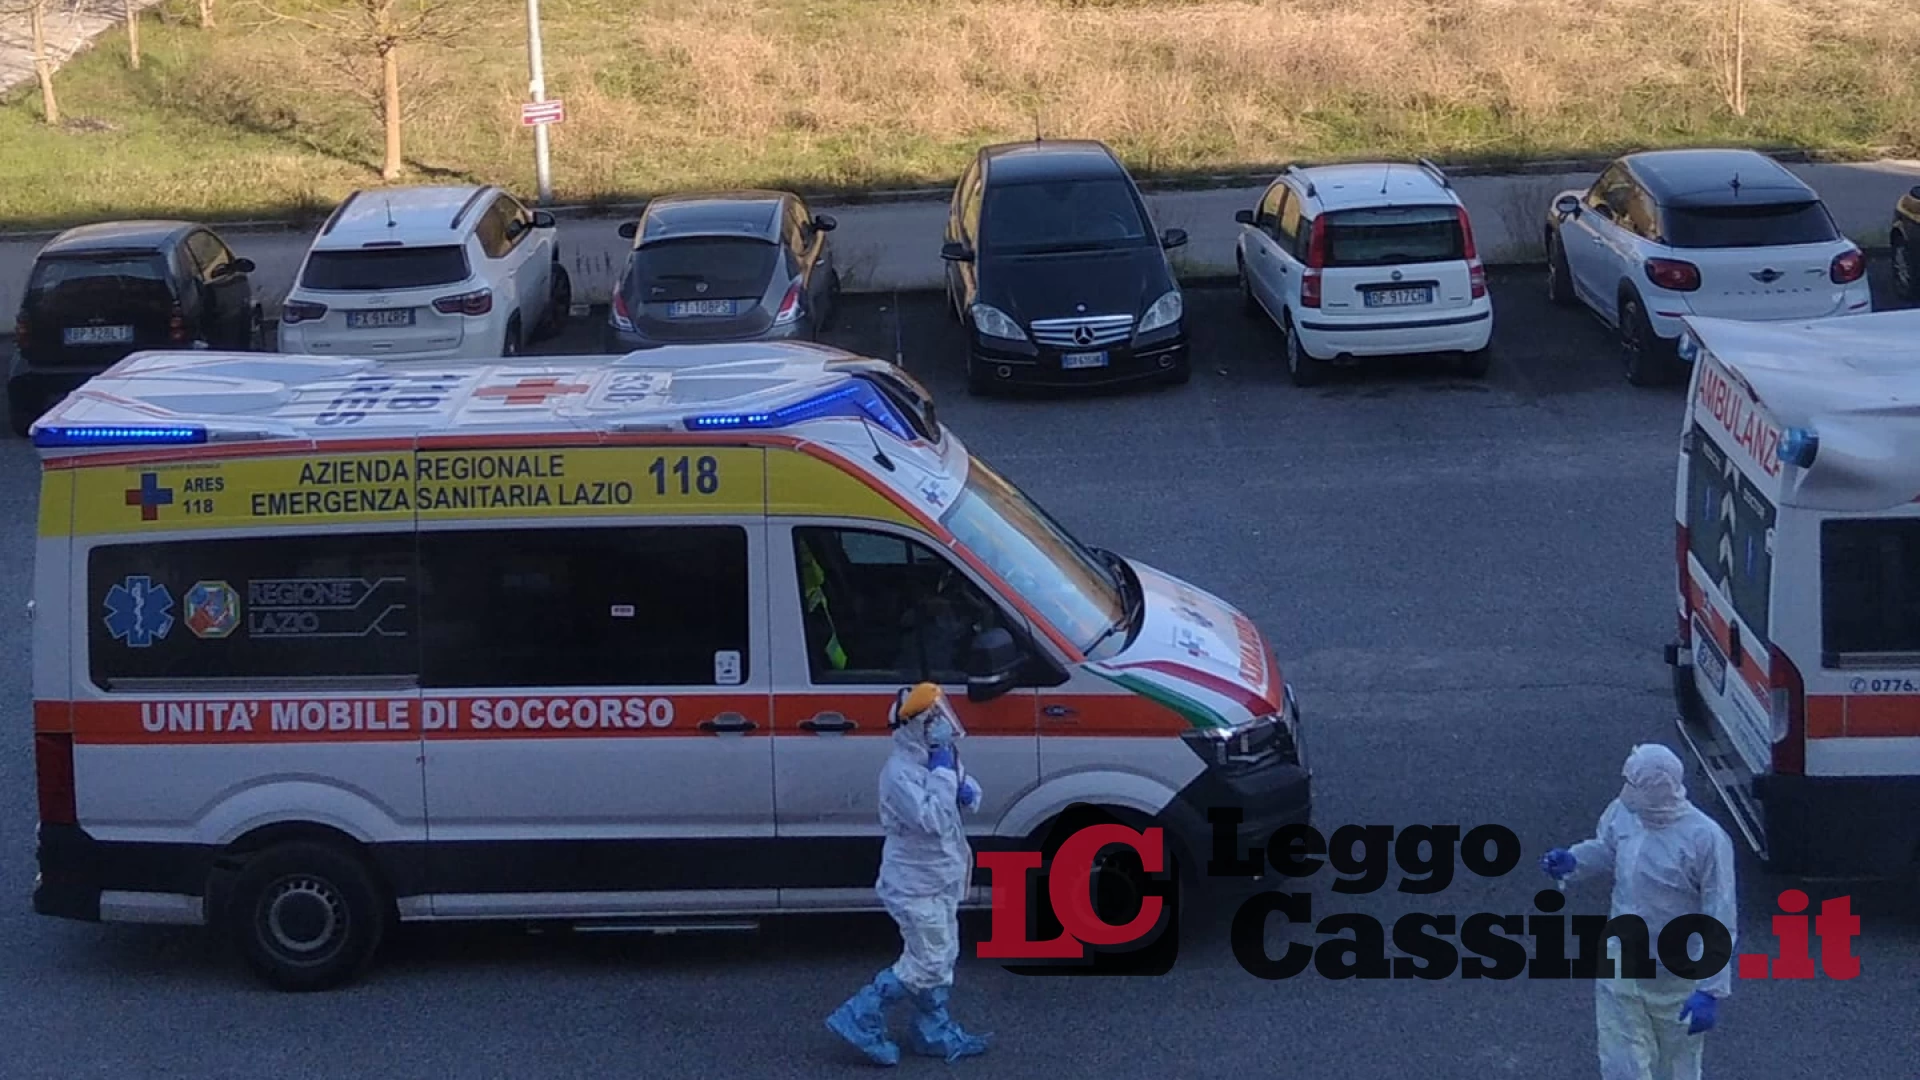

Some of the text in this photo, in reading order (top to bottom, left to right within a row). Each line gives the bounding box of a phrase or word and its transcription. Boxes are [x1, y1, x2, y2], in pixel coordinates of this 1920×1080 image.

[299, 455, 564, 486] AZIENDA REGIONALE
[648, 456, 719, 495] 118
[183, 477, 225, 493] ARES
[183, 499, 214, 514] 118
[251, 481, 633, 517] EMERGENZA SANITARIA LAZIO
[249, 583, 352, 604] REGIONE
[249, 612, 320, 633] LAZIO
[271, 700, 411, 731] MOBILE
[422, 700, 458, 729] DI
[470, 698, 675, 729] SOCCORSO
